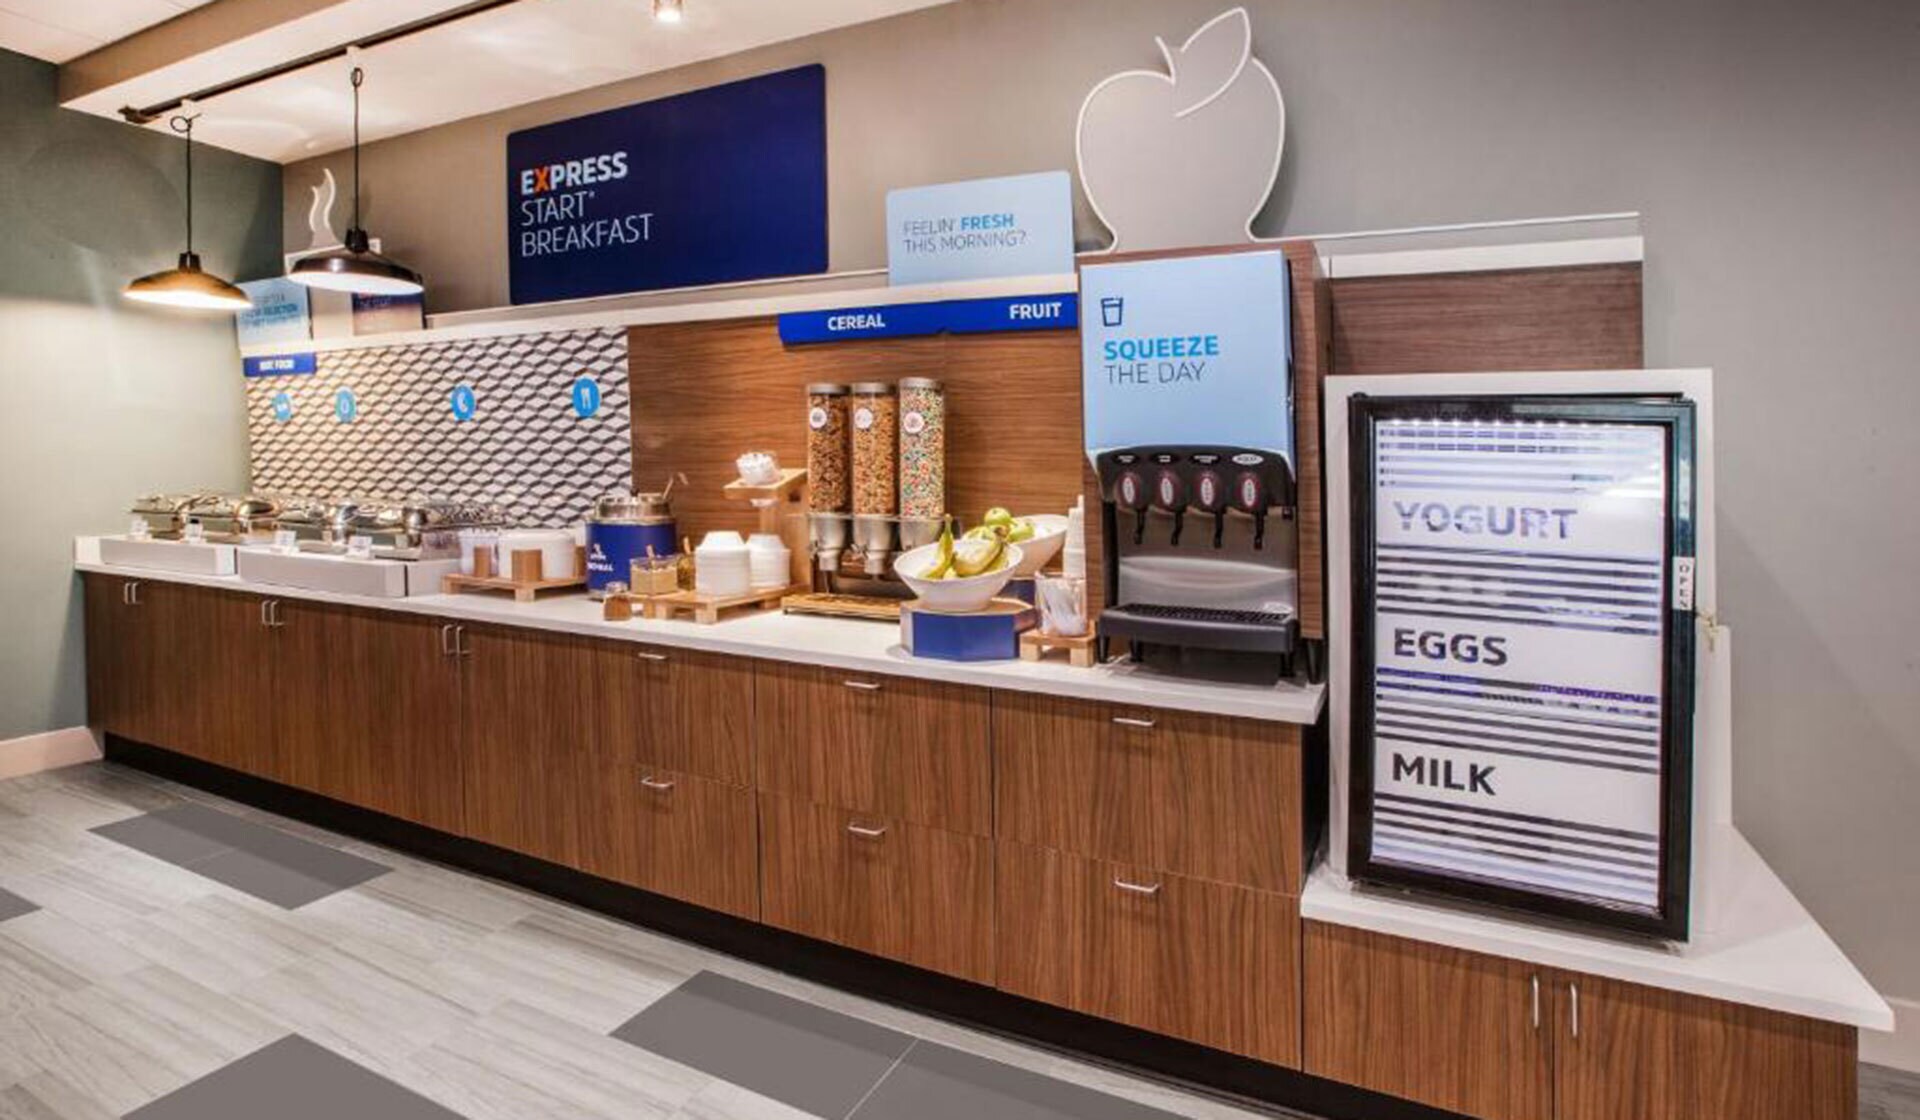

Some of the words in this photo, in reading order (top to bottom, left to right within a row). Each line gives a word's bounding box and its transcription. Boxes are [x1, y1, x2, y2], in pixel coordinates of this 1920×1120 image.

[520, 151, 629, 195] EXPRESS
[521, 213, 654, 258] BREAKFAST
[960, 213, 1015, 231] FRESH
[903, 237, 937, 254] THIS
[941, 231, 1027, 251] MORNING?
[827, 313, 886, 331] CEREAL
[1009, 302, 1063, 320] FRUIT
[1104, 335, 1220, 361] SQUEEZE
[1105, 363, 1149, 385] THE
[1158, 361, 1206, 383] DAY
[1393, 500, 1579, 540] YOGURT
[1679, 564, 1691, 608] OPEN
[1393, 627, 1508, 667] EGGS
[1392, 752, 1497, 796] MILK
